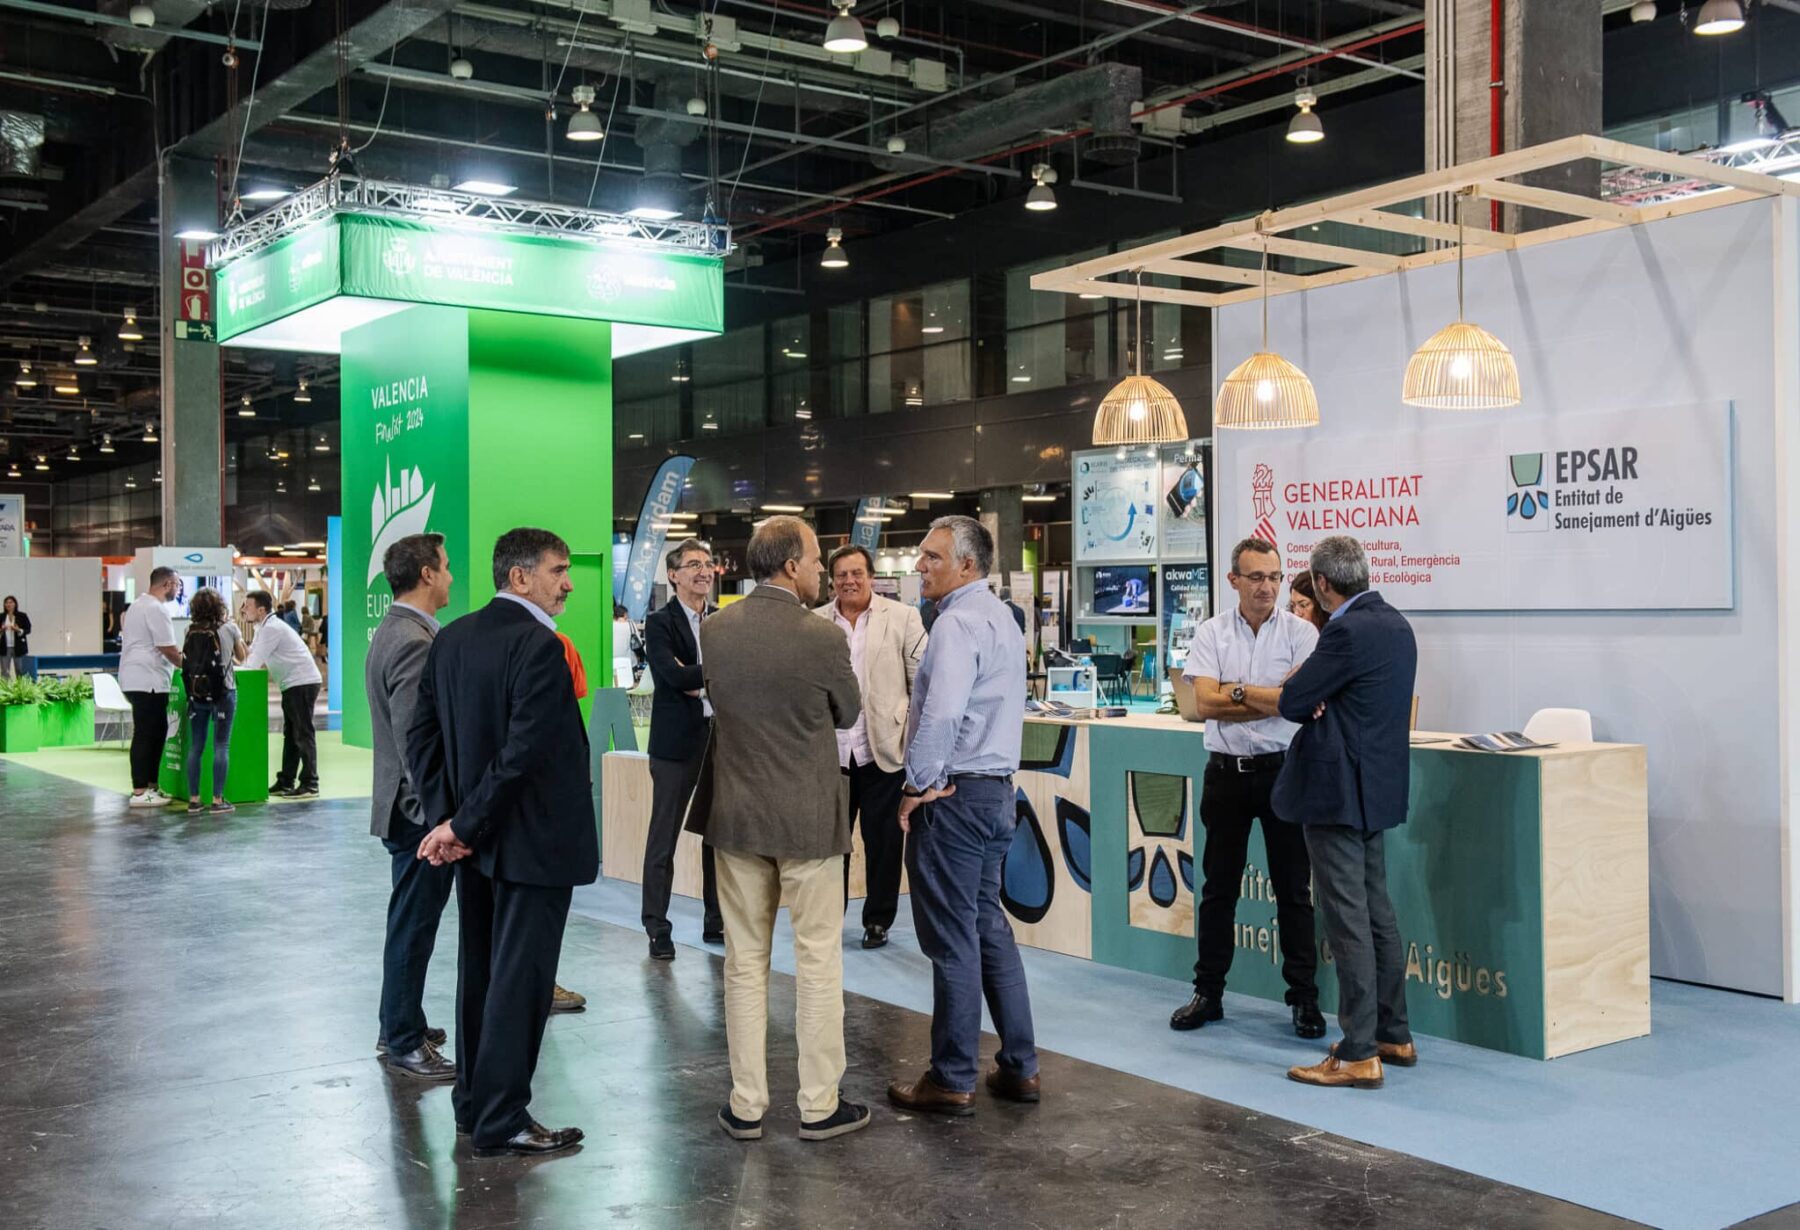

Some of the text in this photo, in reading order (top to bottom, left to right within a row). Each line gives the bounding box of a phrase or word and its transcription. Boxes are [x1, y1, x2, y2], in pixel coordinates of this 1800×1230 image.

[371, 376, 428, 410] VALENCIA
[406, 407, 424, 431] 2024
[1556, 447, 1639, 484] EPSAR
[1284, 475, 1423, 504] GENERALITAT
[1555, 485, 1624, 507] Entitat de
[1286, 505, 1420, 530] VALENCIANA
[1555, 508, 1712, 533] Sanejament d'Aigües
[1287, 554, 1460, 569] Dese Rural, Emergència
[1383, 571, 1432, 585] Ecològica
[367, 594, 394, 618] EUR
[1405, 942, 1508, 999] Aigües
